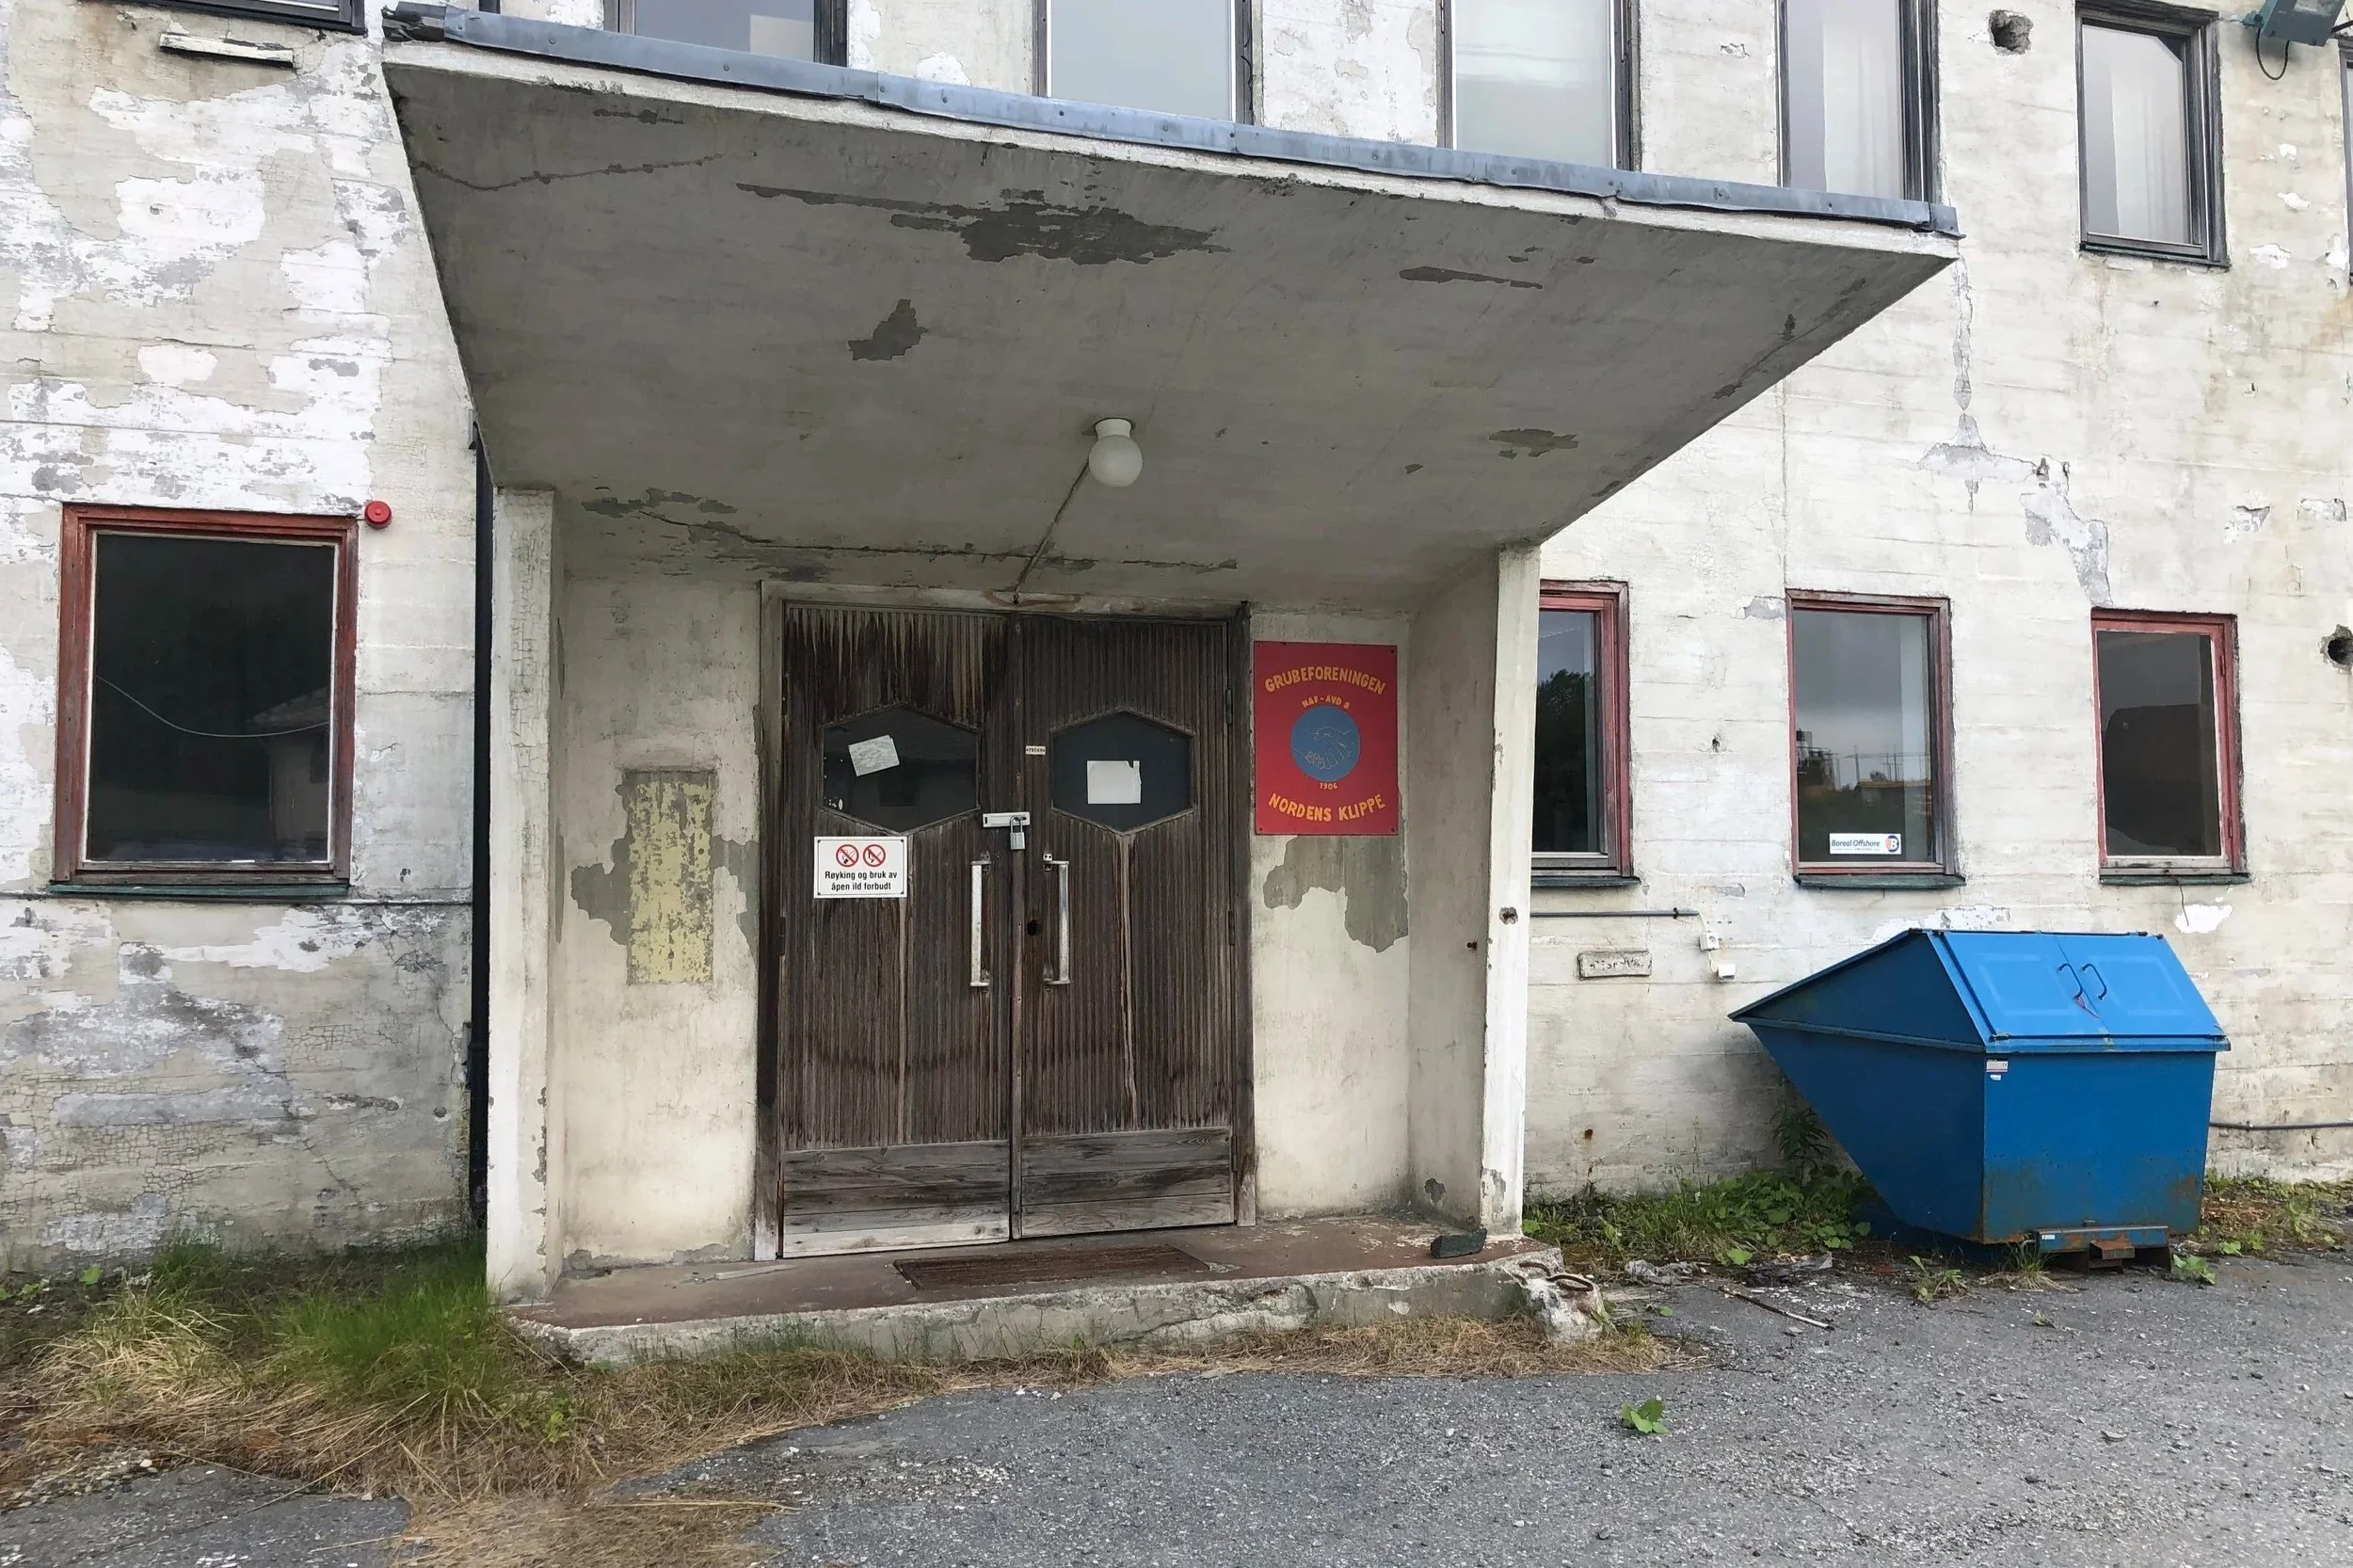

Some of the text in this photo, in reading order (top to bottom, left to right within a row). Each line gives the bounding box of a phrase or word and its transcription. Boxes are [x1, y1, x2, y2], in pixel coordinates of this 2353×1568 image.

[1264, 665, 1386, 696] GRUBEFORENINGEN
[1320, 782, 1337, 791] 1906
[1268, 792, 1385, 822] NORDENS KLIPPE
[1831, 839, 1881, 847] Boreal Offshore
[824, 871, 856, 881] Røyking
[857, 872, 867, 881] og
[870, 871, 887, 879] bruk
[831, 882, 891, 892] åpen ild forbudt
